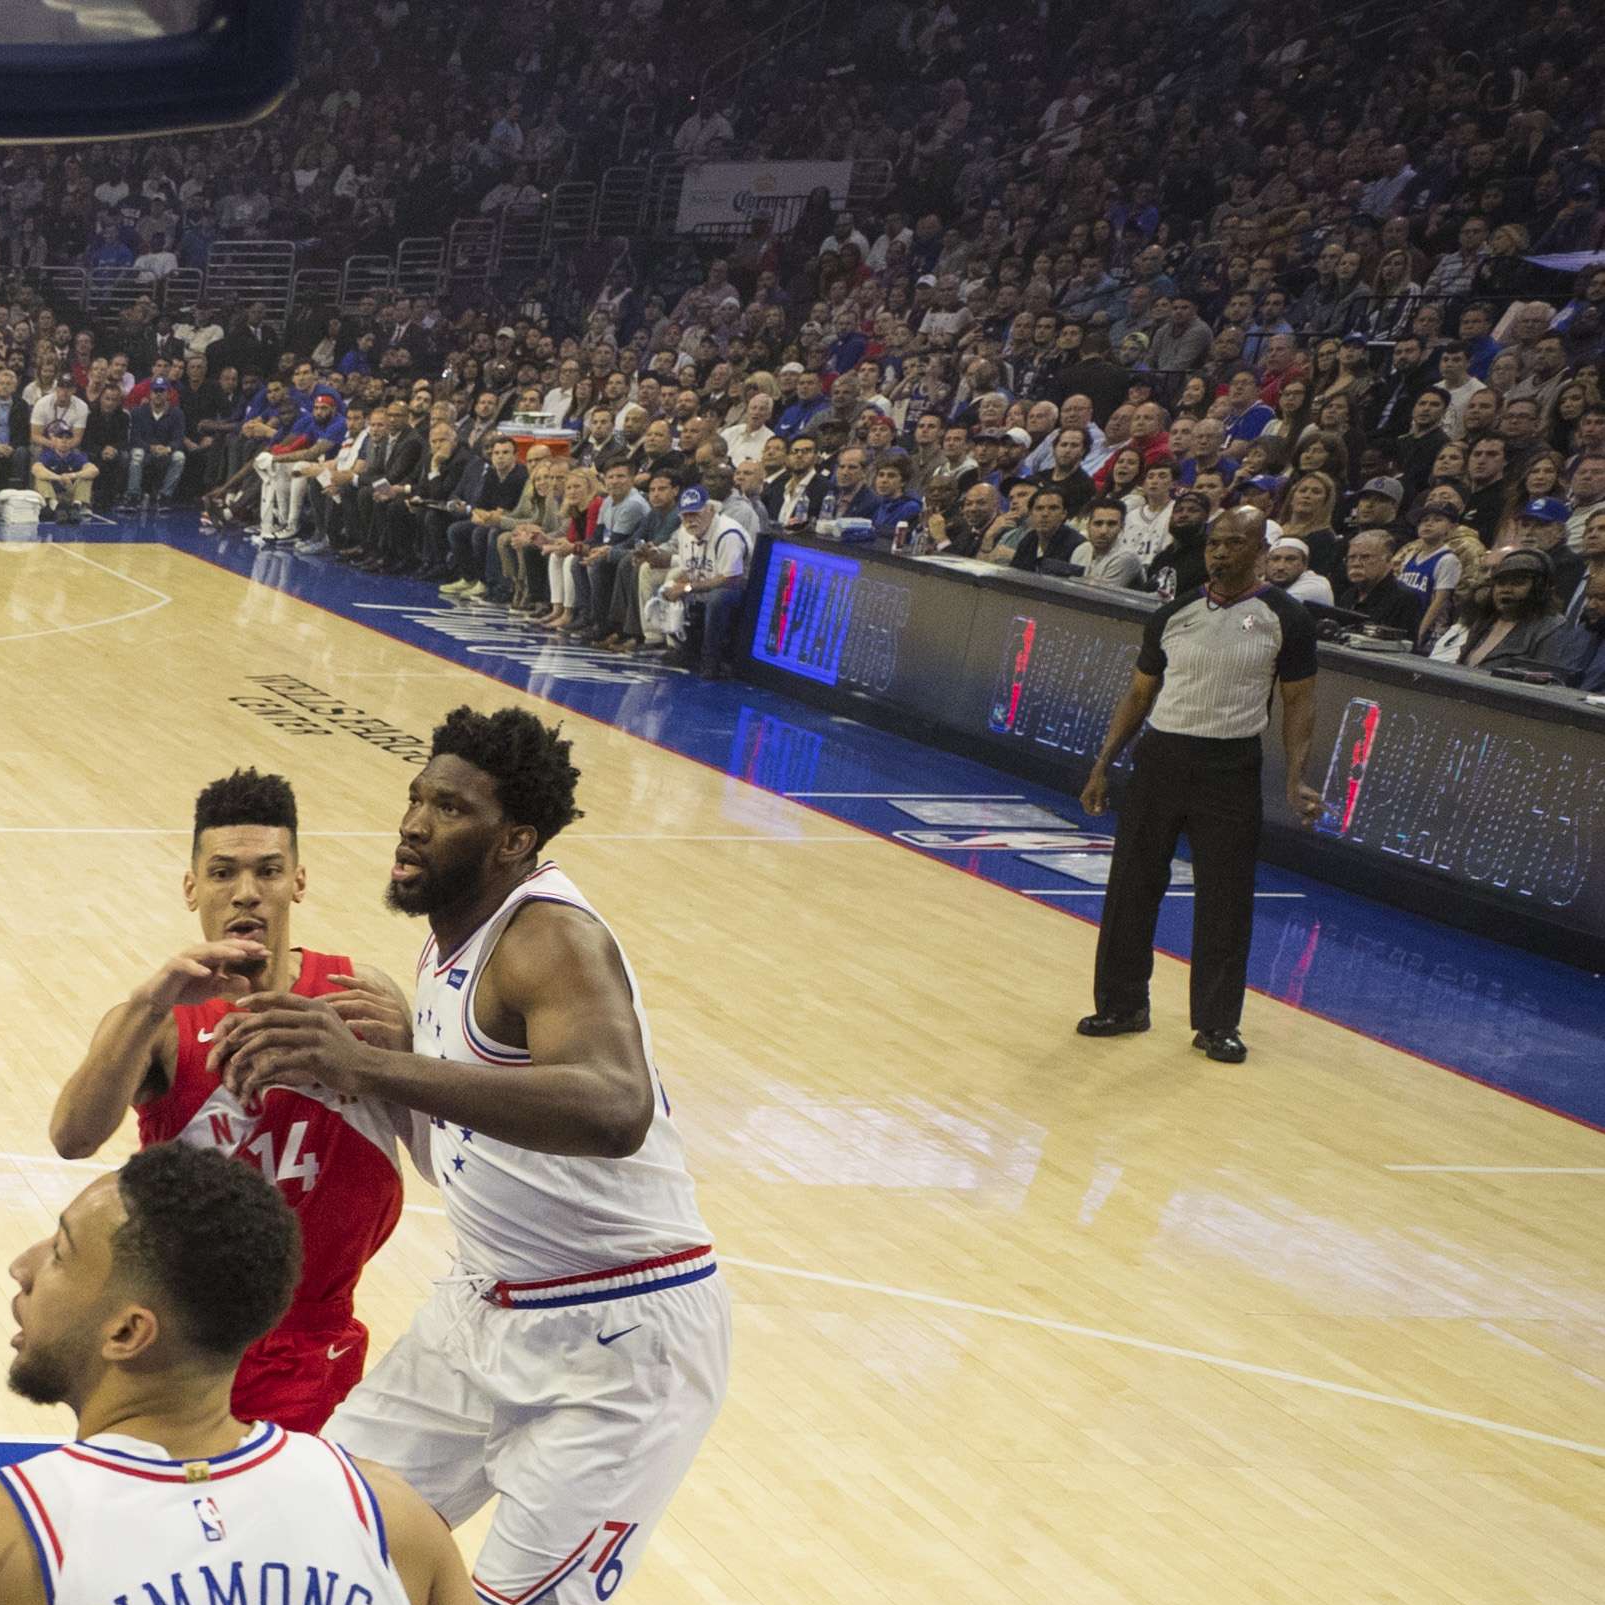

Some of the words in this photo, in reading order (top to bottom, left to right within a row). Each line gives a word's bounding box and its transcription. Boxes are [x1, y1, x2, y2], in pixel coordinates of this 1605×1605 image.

[227, 696, 334, 735] CENTER
[247, 1120, 320, 1192] 14
[588, 1520, 639, 1603] 76
